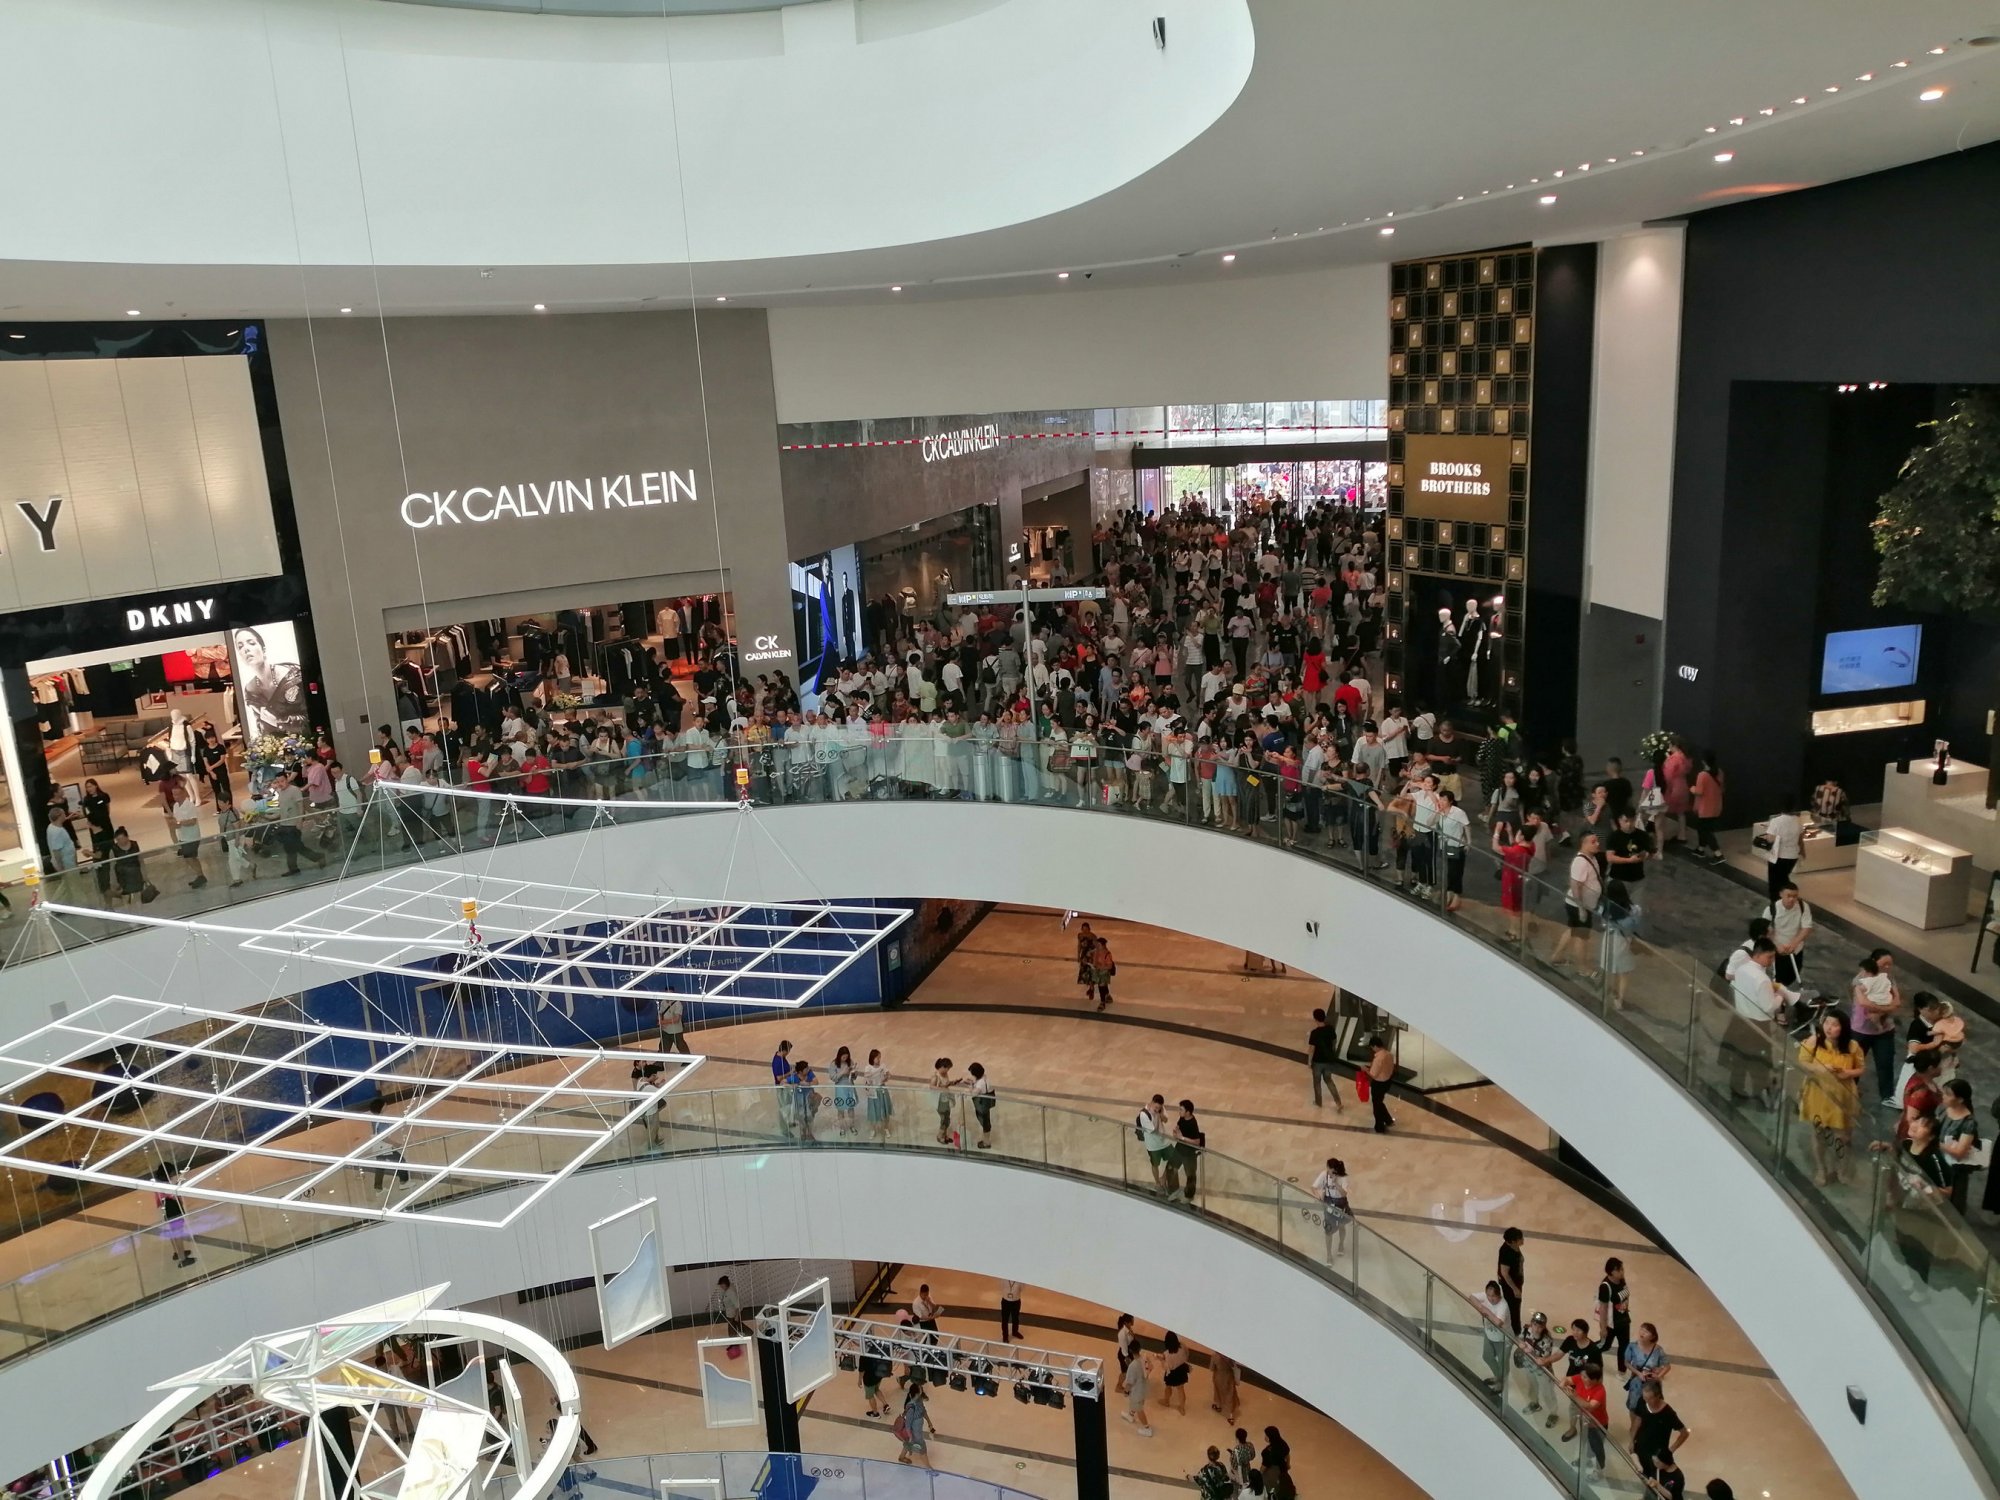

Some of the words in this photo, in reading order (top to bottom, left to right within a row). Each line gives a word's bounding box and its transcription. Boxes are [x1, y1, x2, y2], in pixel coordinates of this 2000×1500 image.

[922, 434, 940, 463] CK
[939, 427, 974, 459] CALVIN
[974, 423, 999, 452] KLEIN
[1430, 461, 1482, 477] BROOKS
[1421, 479, 1491, 496] BROTHERS
[401, 488, 461, 528] CK
[462, 478, 594, 522] CALVIN
[601, 469, 698, 509] KLEIN
[0, 497, 62, 553] Y
[126, 598, 214, 632] DKNY
[755, 635, 779, 650] CK
[745, 651, 772, 661] CALVIN
[772, 649, 792, 659] KLEIN
[717, 956, 743, 967] FUTURE
